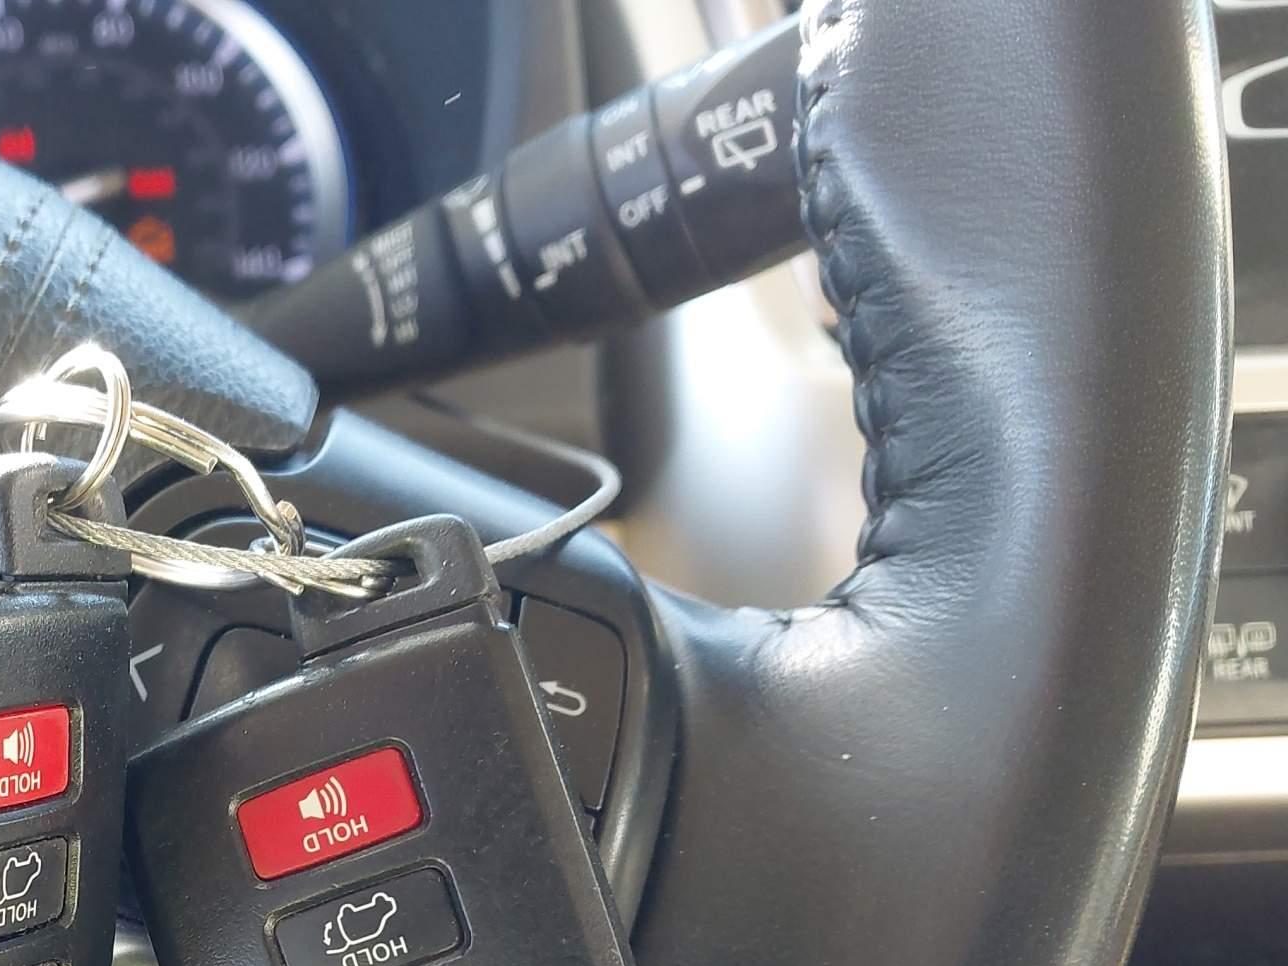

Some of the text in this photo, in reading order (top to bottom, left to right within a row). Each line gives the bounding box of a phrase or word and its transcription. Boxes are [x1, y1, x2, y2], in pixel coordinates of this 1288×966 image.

[696, 89, 776, 138] REAR
[619, 184, 669, 229] OFF
[1213, 657, 1270, 680] REAR
[303, 815, 369, 853] HOLD
